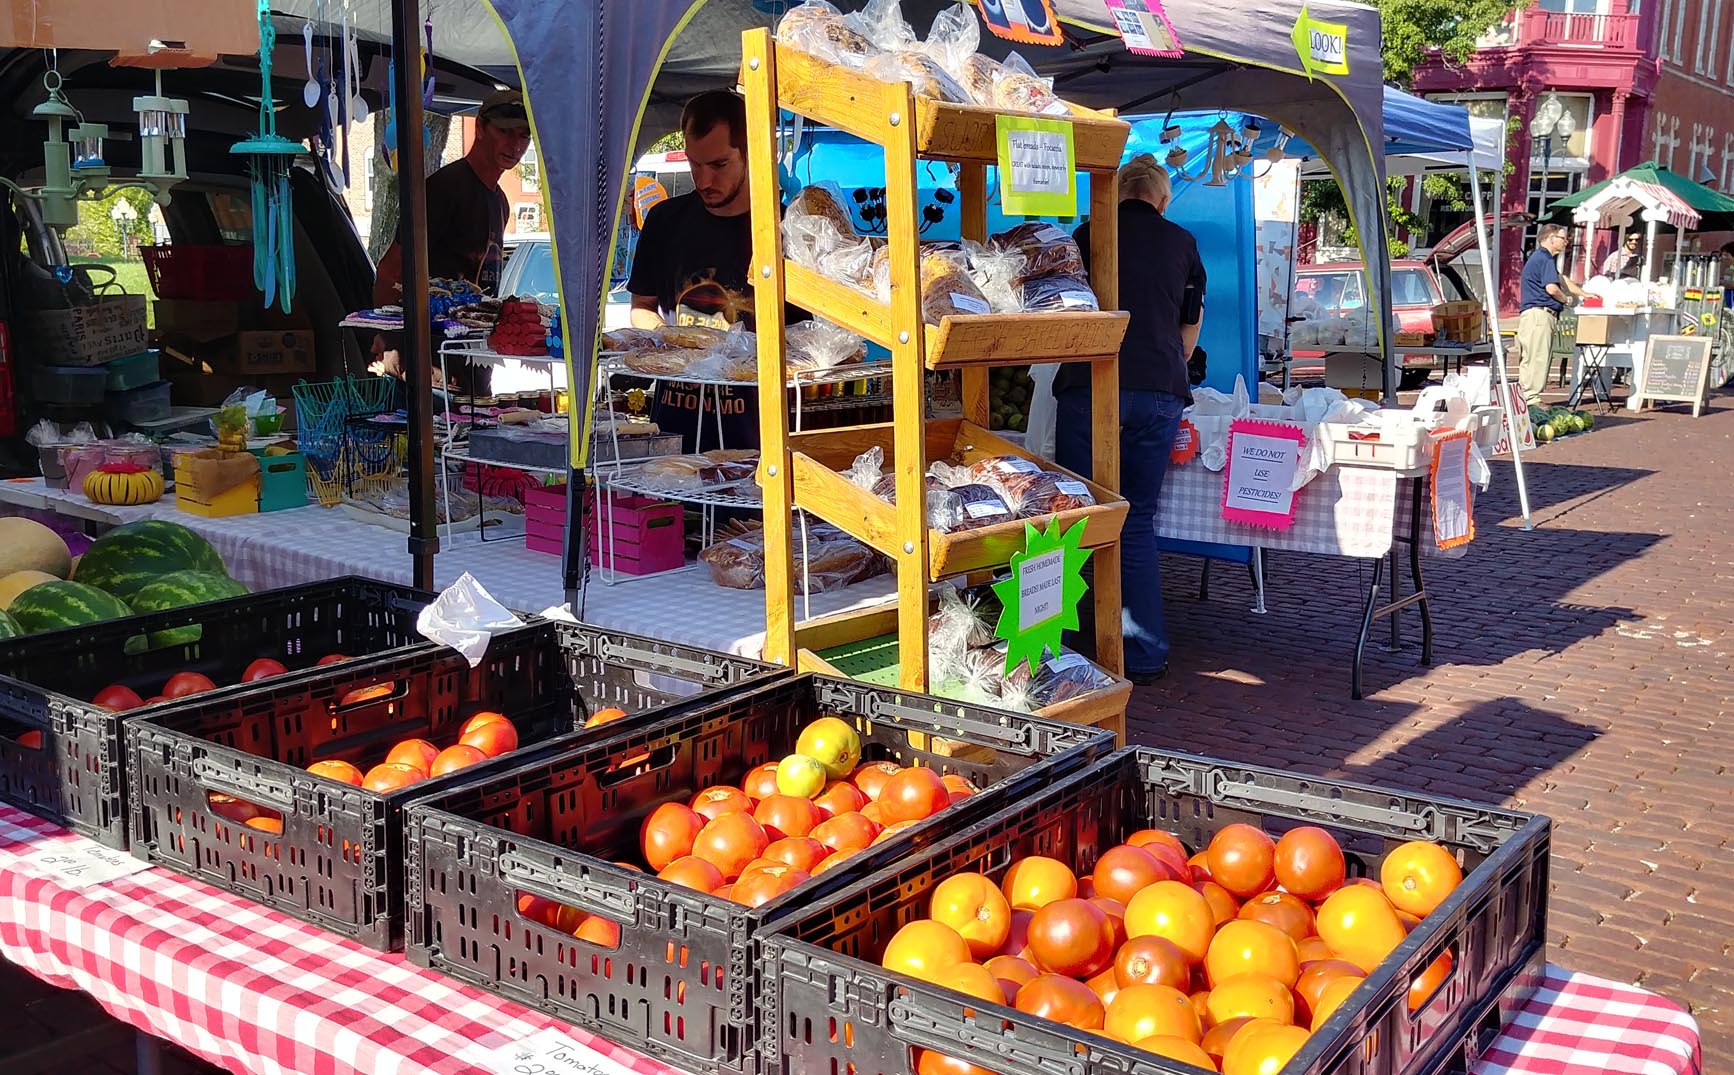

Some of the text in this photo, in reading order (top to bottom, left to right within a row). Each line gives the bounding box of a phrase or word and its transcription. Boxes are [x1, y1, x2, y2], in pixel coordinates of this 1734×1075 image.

[1309, 30, 1342, 54] LOOK!
[1012, 139, 1022, 149] Flat
[1023, 140, 1038, 150] breads
[1243, 446, 1286, 460] WE DO NOT
[1254, 468, 1270, 478] USE
[1238, 486, 1282, 500] PESTICIDES!
[1022, 555, 1061, 576] FRESH HOMEMADE
[1039, 580, 1052, 593] MADE
[1051, 575, 1062, 587] LAST
